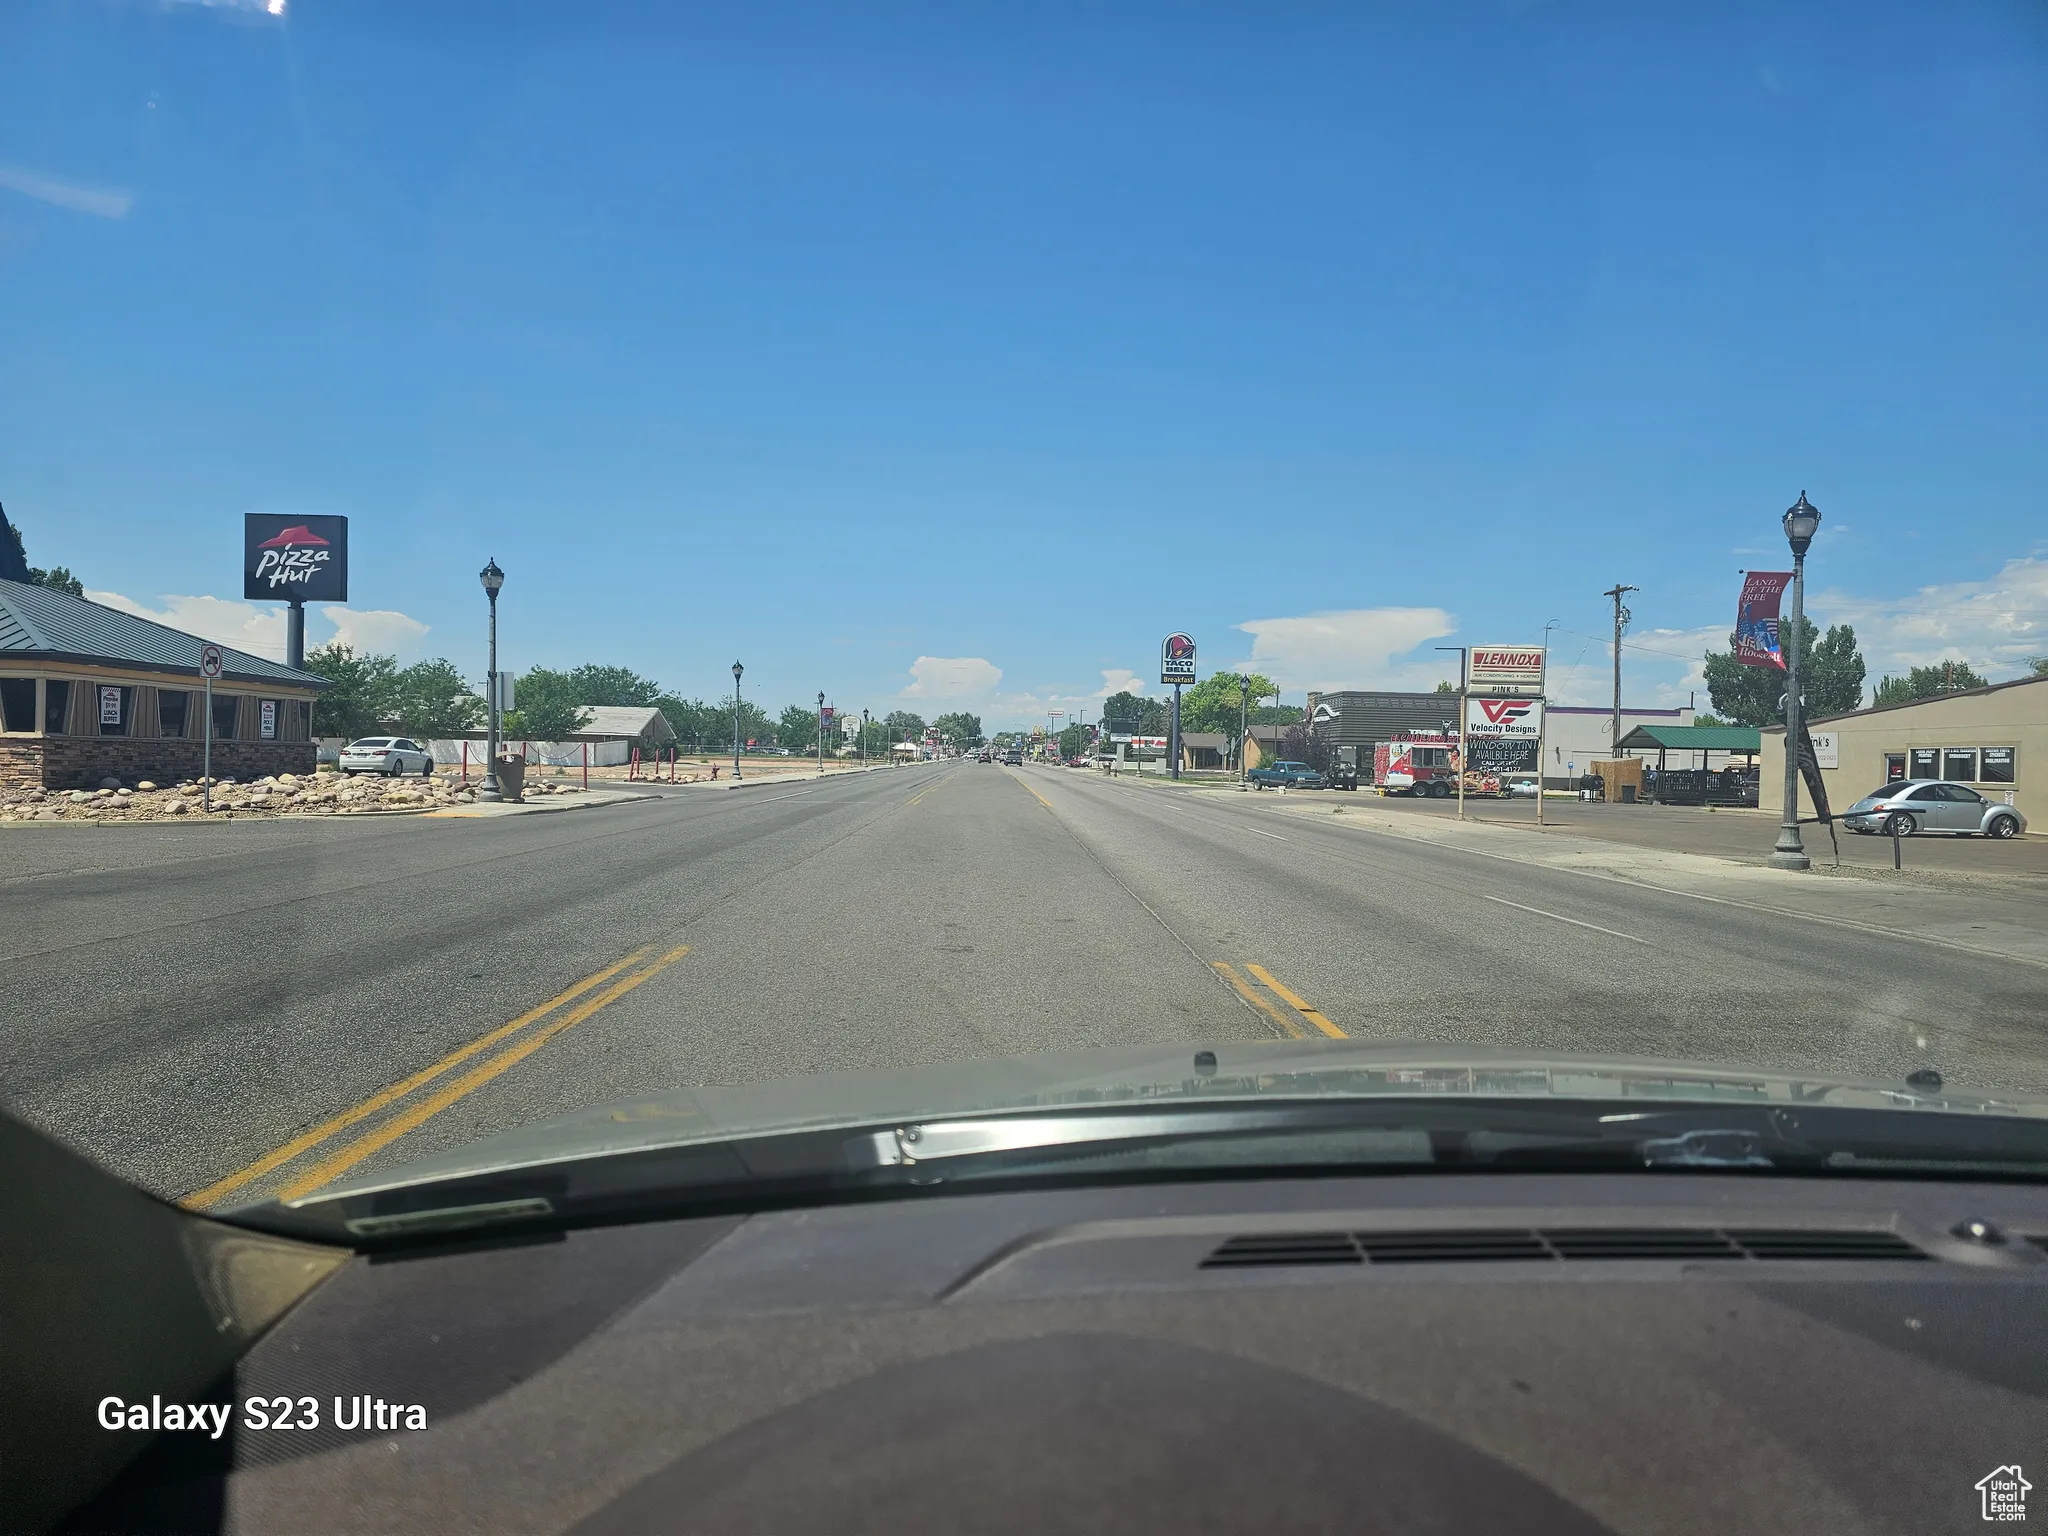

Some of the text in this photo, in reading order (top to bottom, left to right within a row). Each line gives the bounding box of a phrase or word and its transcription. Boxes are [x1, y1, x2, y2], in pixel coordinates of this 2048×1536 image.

[256, 542, 330, 578] Pizza
[268, 564, 322, 588] Hut
[1745, 577, 1777, 586] LAND
[1741, 593, 1767, 601] FREE
[1482, 652, 1536, 666] LENNOX
[1739, 647, 1781, 662] Rooseelt
[1471, 723, 1537, 734] Velocity Designs
[1469, 739, 1539, 750] WINDOW TINT
[1811, 735, 1830, 747] ink's
[1475, 750, 1529, 760] AVAILBLE HERE
